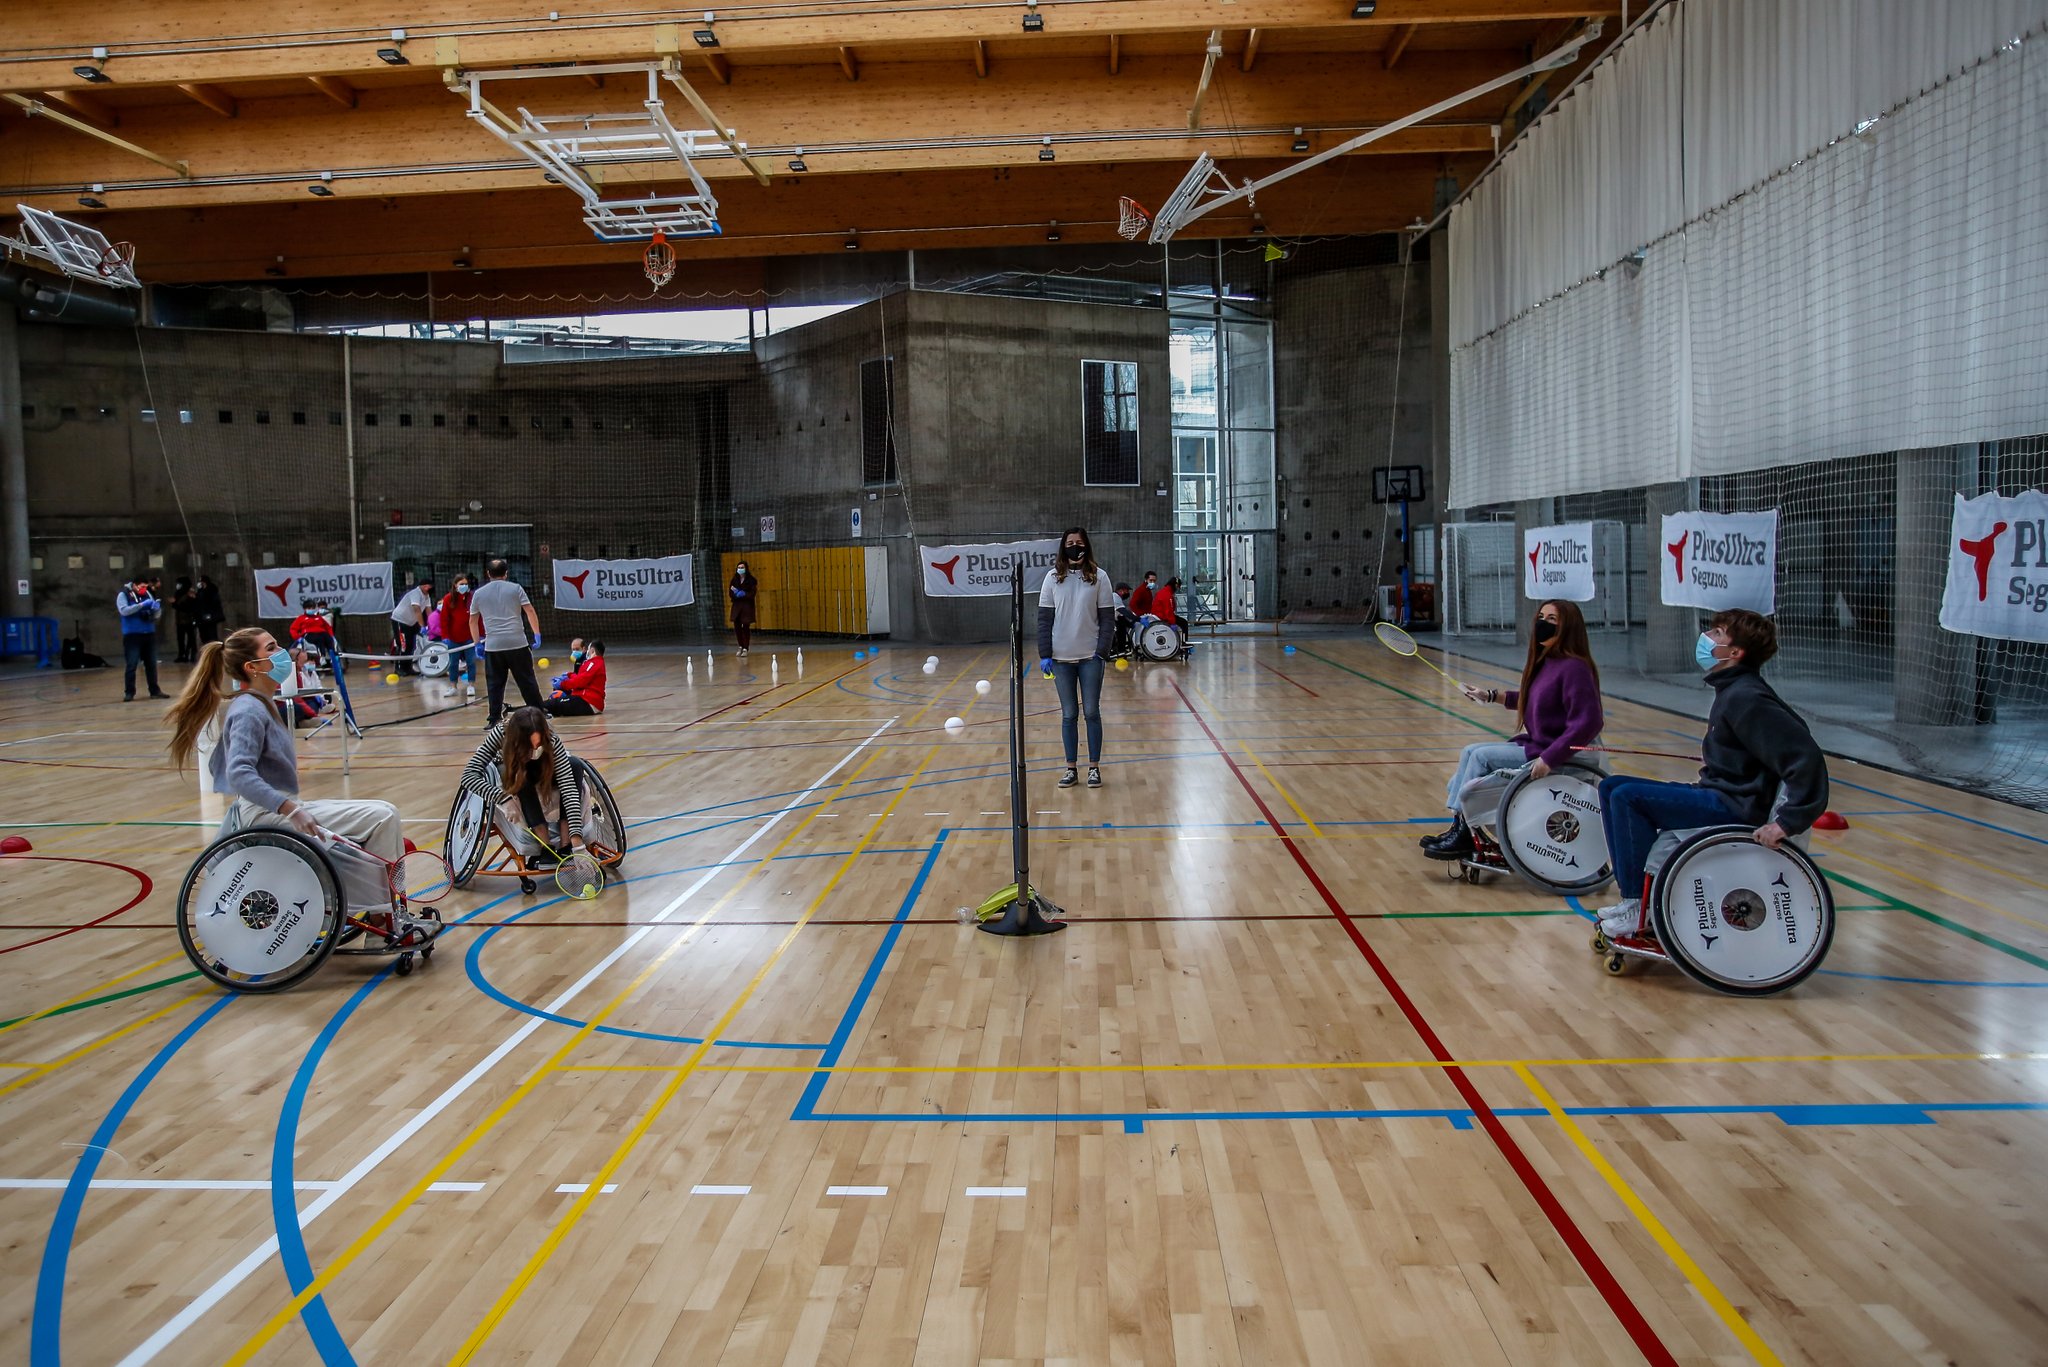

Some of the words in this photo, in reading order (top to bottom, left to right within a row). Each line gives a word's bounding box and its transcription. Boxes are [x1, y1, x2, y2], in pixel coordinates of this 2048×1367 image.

[1542, 539, 1588, 564] PlusUltra
[1691, 530, 1767, 566] PlusUltra
[297, 573, 385, 594] PlusUltra
[596, 568, 684, 586] PlusUltra
[967, 574, 1012, 587] Seguro
[1542, 568, 1566, 586] Seguros
[1691, 566, 1728, 590] Seguros
[597, 588, 644, 601] Seguros
[1562, 792, 1602, 815] PlusUltra
[1526, 841, 1566, 865] PlusUltra
[219, 860, 254, 904] PlusUltra
[1693, 878, 1710, 931] PlusUltra
[1707, 901, 1718, 929] Seguros
[1773, 892, 1783, 921] Seguros
[273, 909, 293, 933] Seguros
[1780, 891, 1798, 944] PlusUltra
[265, 913, 301, 956] PlusUltra
